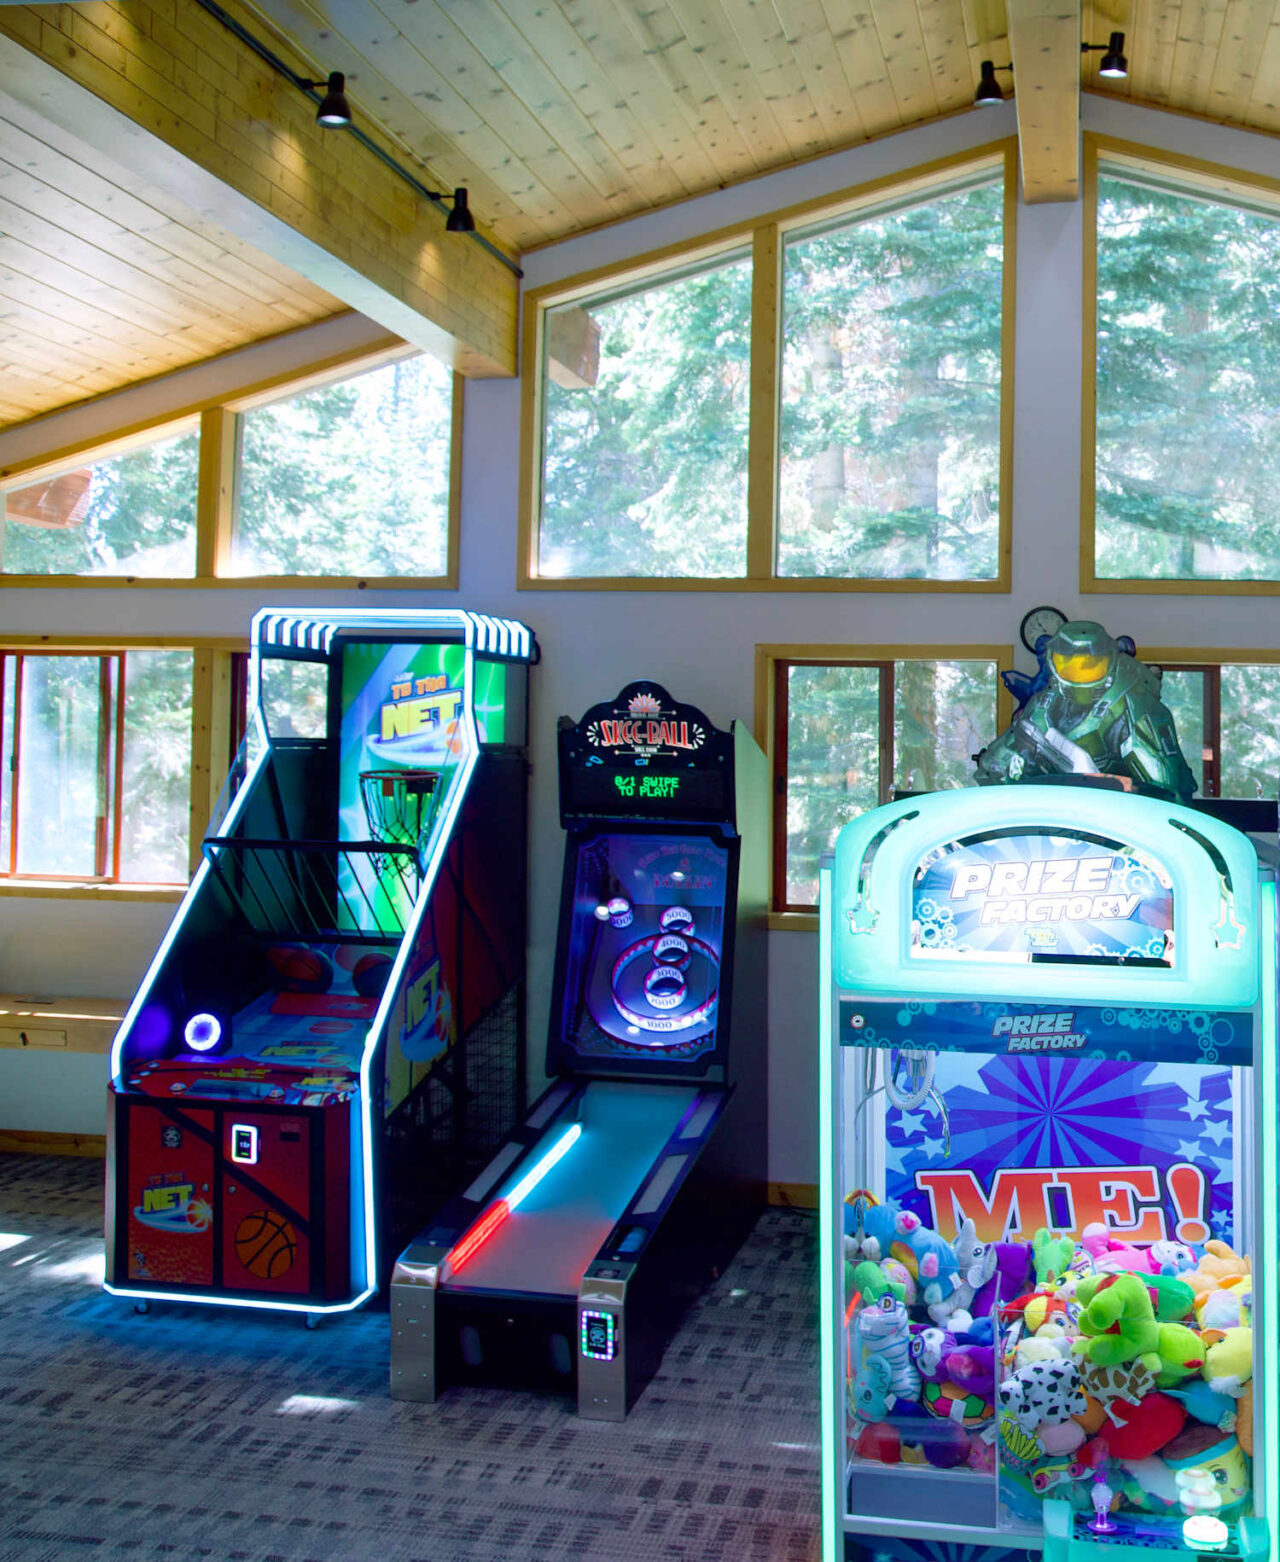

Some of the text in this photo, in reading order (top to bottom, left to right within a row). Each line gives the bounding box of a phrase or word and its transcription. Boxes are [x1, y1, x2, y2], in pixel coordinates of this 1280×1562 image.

[381, 691, 462, 740] NET
[619, 786, 675, 798] TO PLAY!
[643, 777, 679, 788] SWIPE
[951, 857, 1114, 900] PRIZE
[980, 894, 1145, 926] FACTORY
[992, 1012, 1073, 1036] PRIZE
[1007, 1034, 1086, 1051] FACTORY
[143, 1185, 193, 1212] NET
[915, 1162, 1211, 1245] ME!
